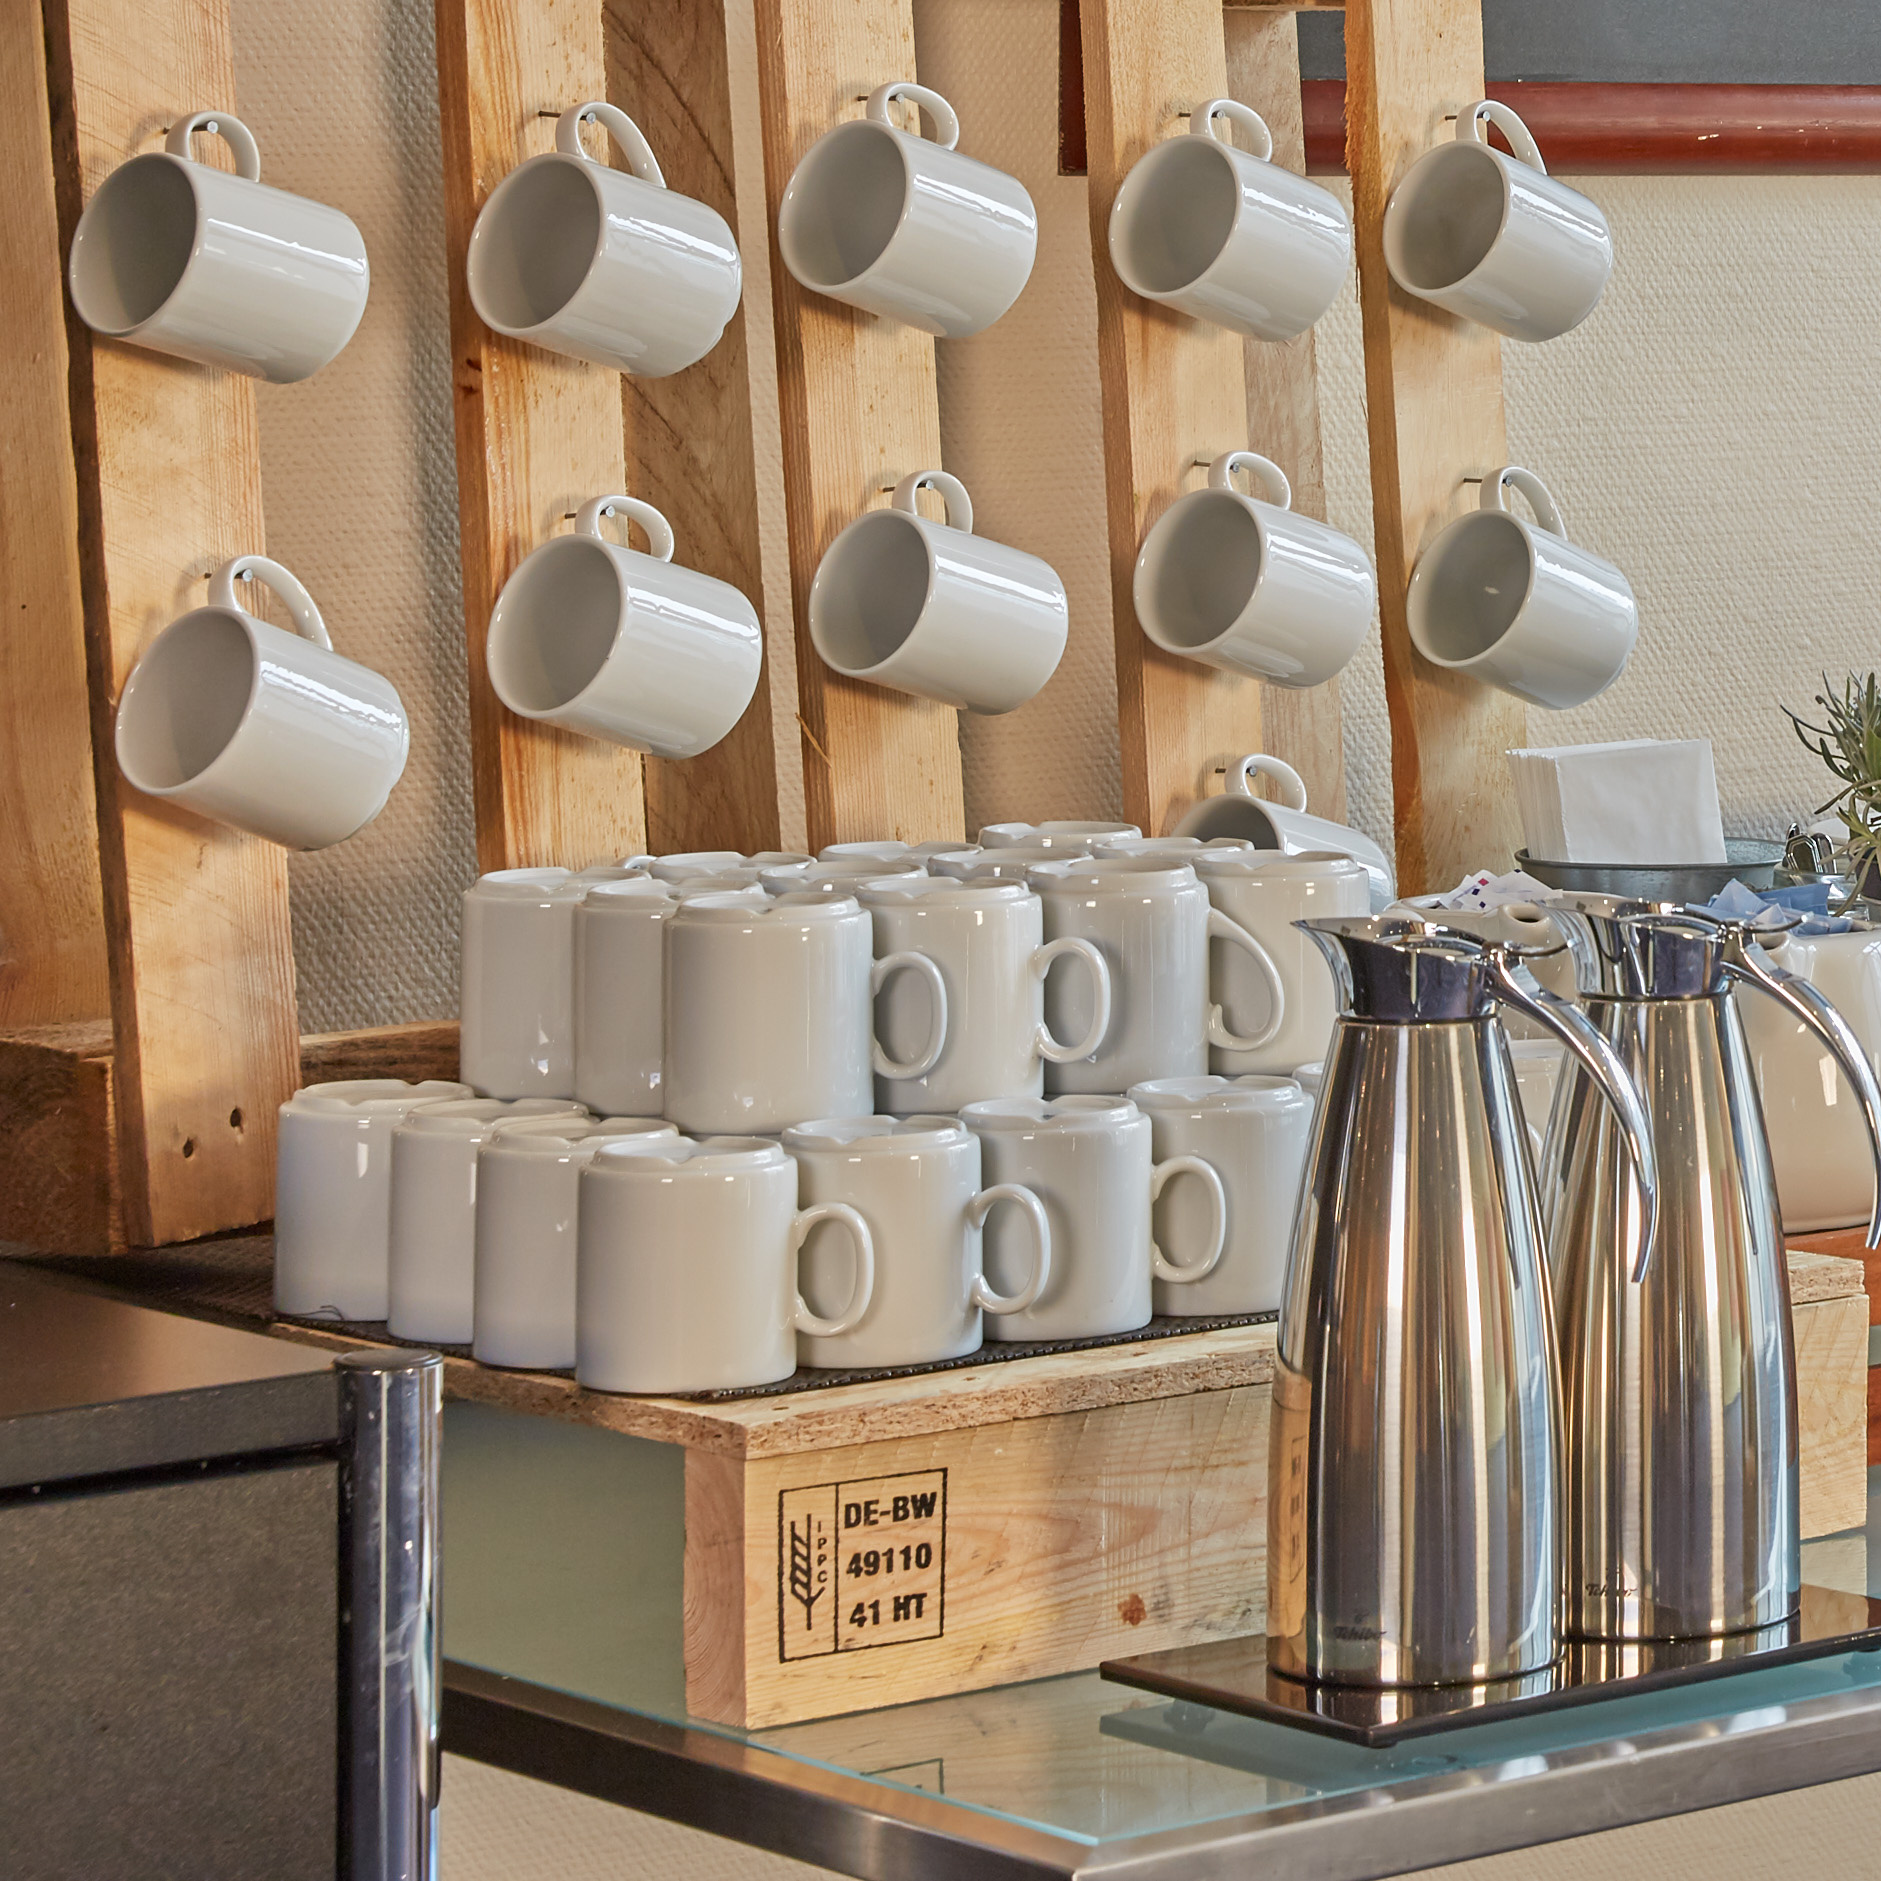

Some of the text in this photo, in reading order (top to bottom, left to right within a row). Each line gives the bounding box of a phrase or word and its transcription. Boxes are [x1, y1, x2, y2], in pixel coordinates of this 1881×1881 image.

[844, 1491, 937, 1529] DE-BW
[846, 1542, 932, 1579] 49110
[849, 1592, 928, 1628] 41 HT
